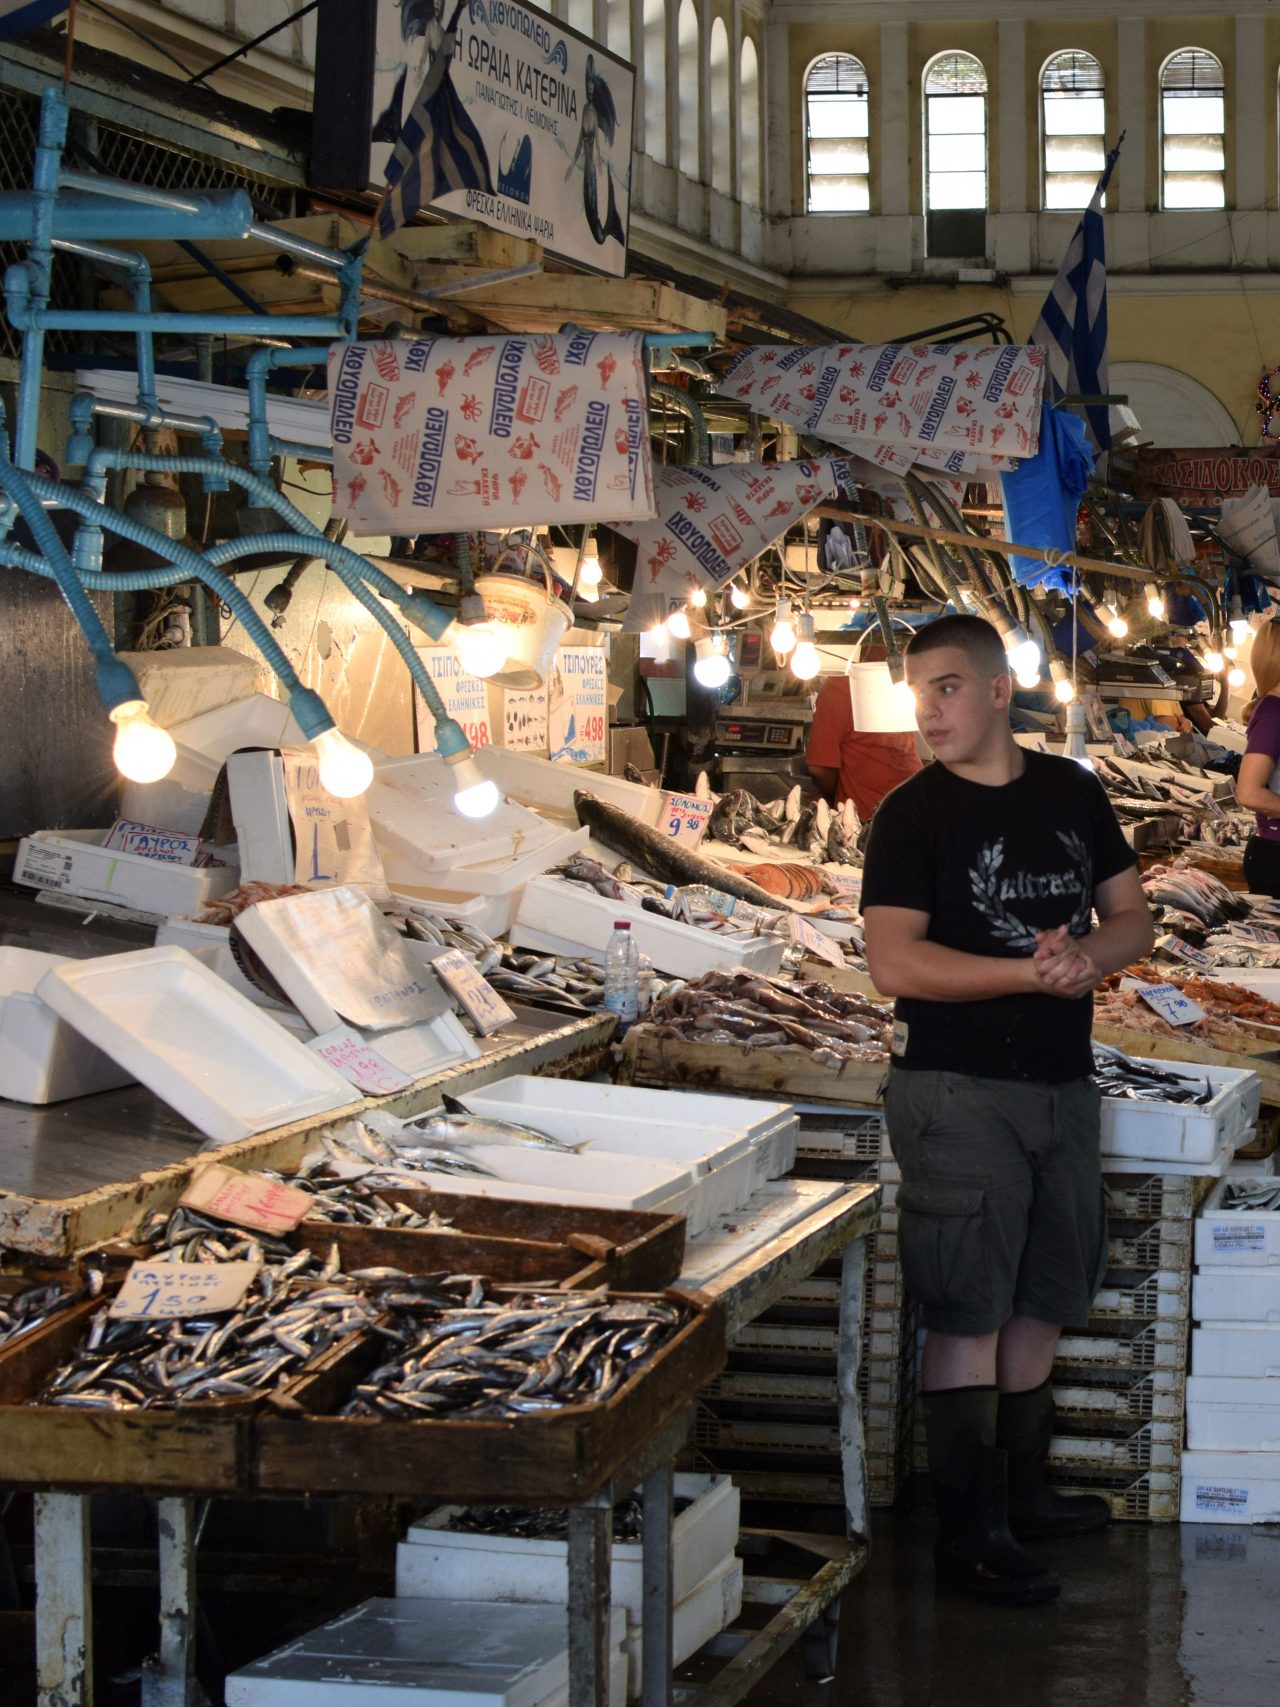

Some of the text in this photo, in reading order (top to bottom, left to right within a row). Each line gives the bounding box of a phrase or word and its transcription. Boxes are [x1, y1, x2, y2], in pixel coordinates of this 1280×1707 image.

[468, 34, 511, 87] ΩΡΑΙΑ
[516, 58, 578, 121] ΚΑΤΕΡΙΝΑ
[466, 190, 554, 240] ΦΡΕΣΚΑ ΕΛΛΗΝΙΚΑ ΨΑΡΙΑ
[333, 346, 366, 443] ΙΧΘΥΟΠΩΛΕΙΟ
[492, 341, 528, 438] ΙΧΘΥΟΠΩΛΕΙΟ
[918, 376, 954, 441] ΙΧΘΥΟΠΩΛΕΙΟ
[412, 406, 445, 507] ΙΧΘΥΟΠΩΛΕΙΟ
[573, 400, 606, 502] ΙΧΘΥΟΠΩΛΕΙΟ
[667, 511, 733, 579] ΙΧΘΥΟΠΩΛΕΙΟ
[563, 654, 604, 675] ΤΣΙΠΟΥΡΕΣ
[129, 834, 191, 851] ΓΑΥΡΟΣ
[668, 817, 682, 837] 9
[131, 1269, 219, 1281] ΓΑΥΡΟΣ
